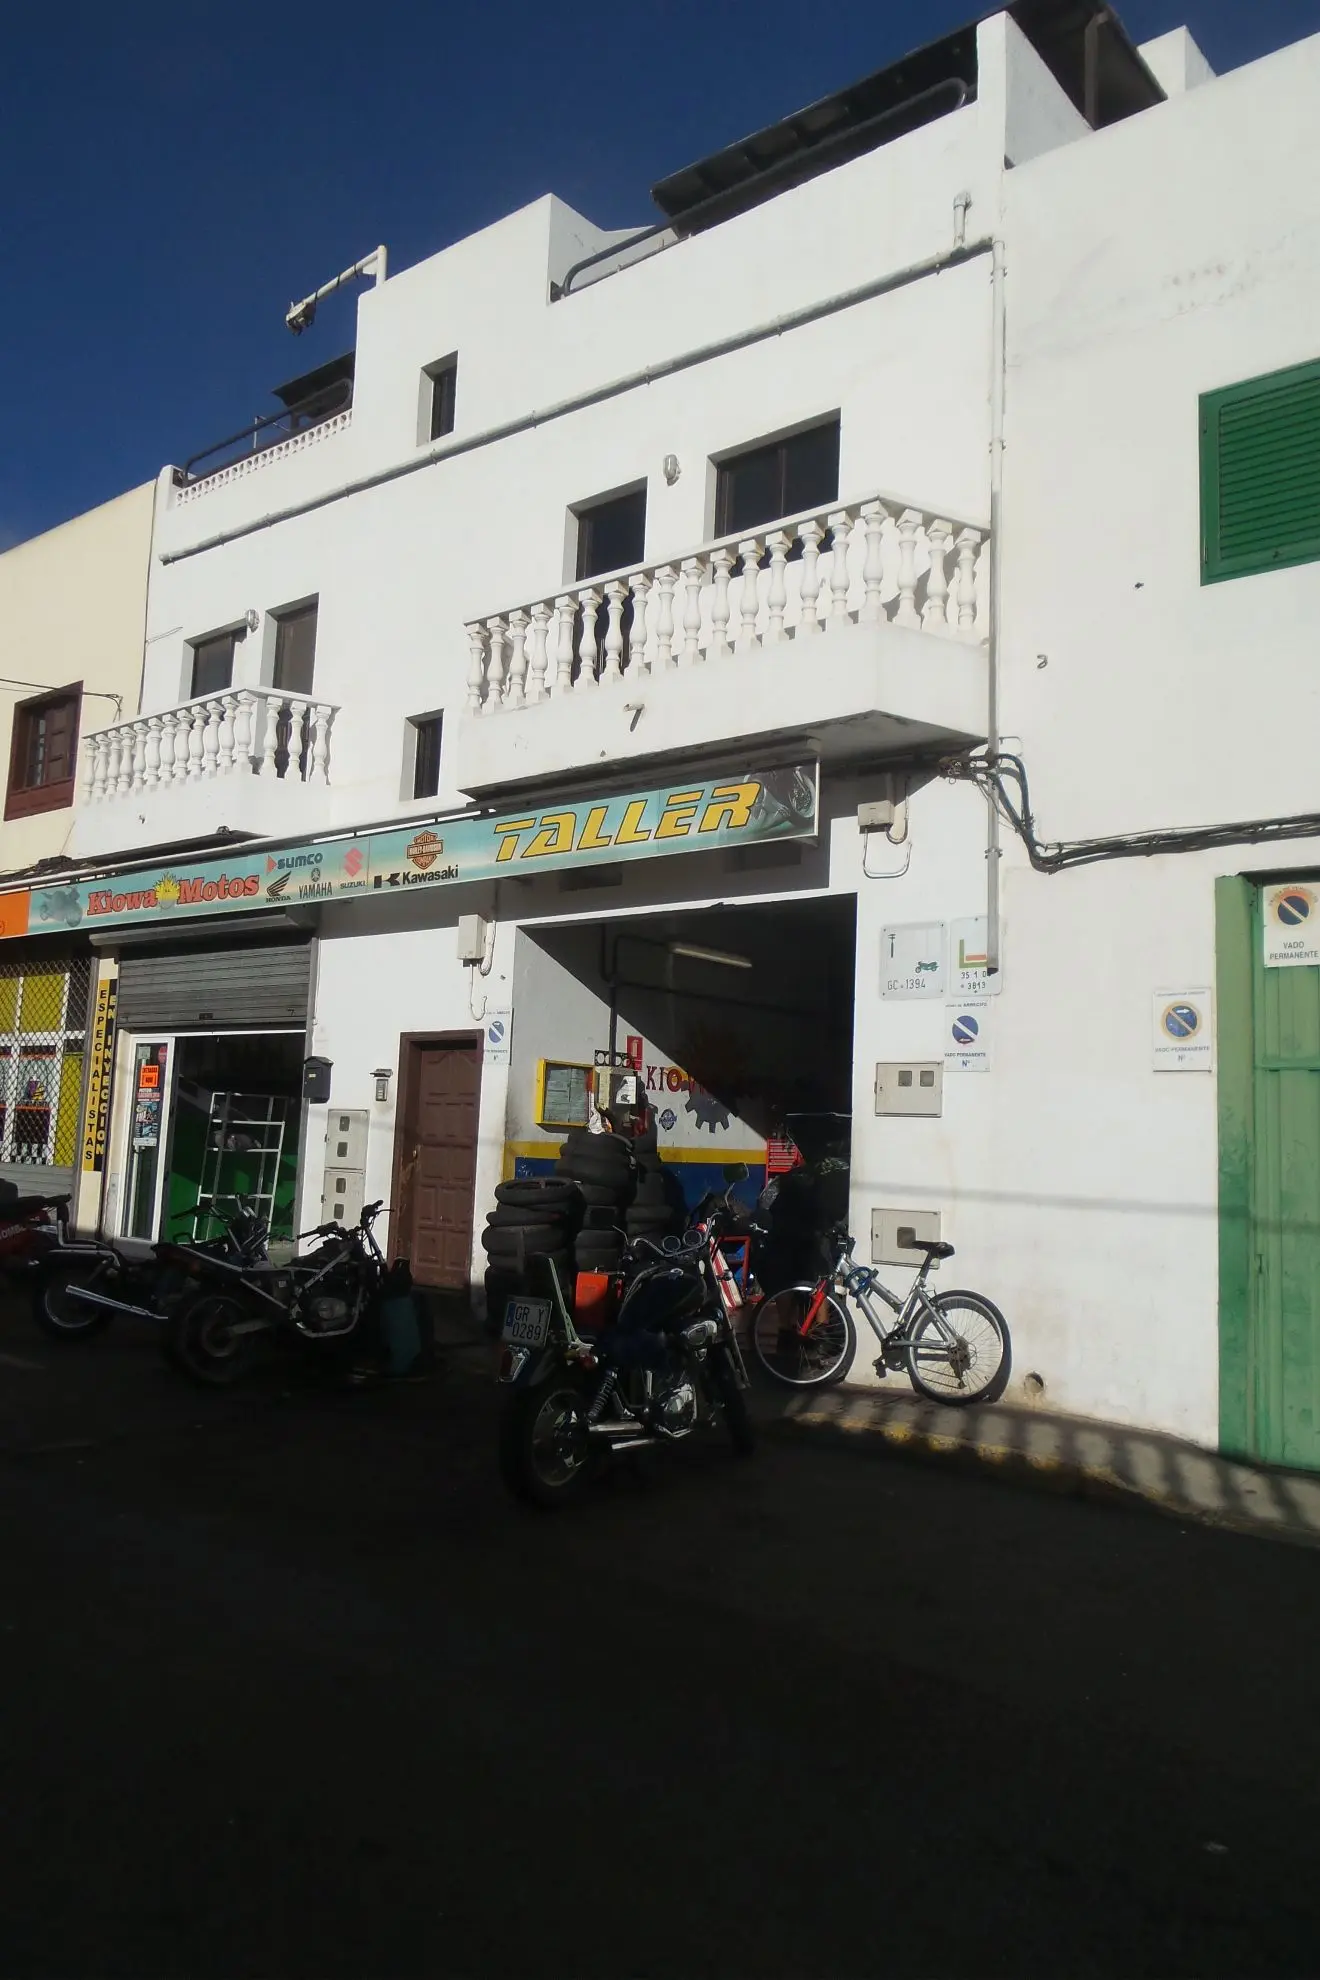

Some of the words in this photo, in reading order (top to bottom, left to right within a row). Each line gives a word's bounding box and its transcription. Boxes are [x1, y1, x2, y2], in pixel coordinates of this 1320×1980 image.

[494, 781, 762, 862] TALLER
[402, 864, 459, 885] Kawasaki
[299, 881, 333, 900] YAMAHA
[340, 880, 366, 890] SUZUKI
[87, 887, 156, 916] Kiowa
[177, 873, 260, 905] Motos
[266, 895, 292, 904] HONDA
[1282, 941, 1305, 949] VADO
[1269, 950, 1319, 960] PERMANENTE
[960, 971, 970, 979] 35
[887, 979, 899, 991] GC
[905, 978, 926, 990] 1394
[85, 989, 107, 1160] ESPECIALISTAS
[512, 1322, 542, 1341] 0289
